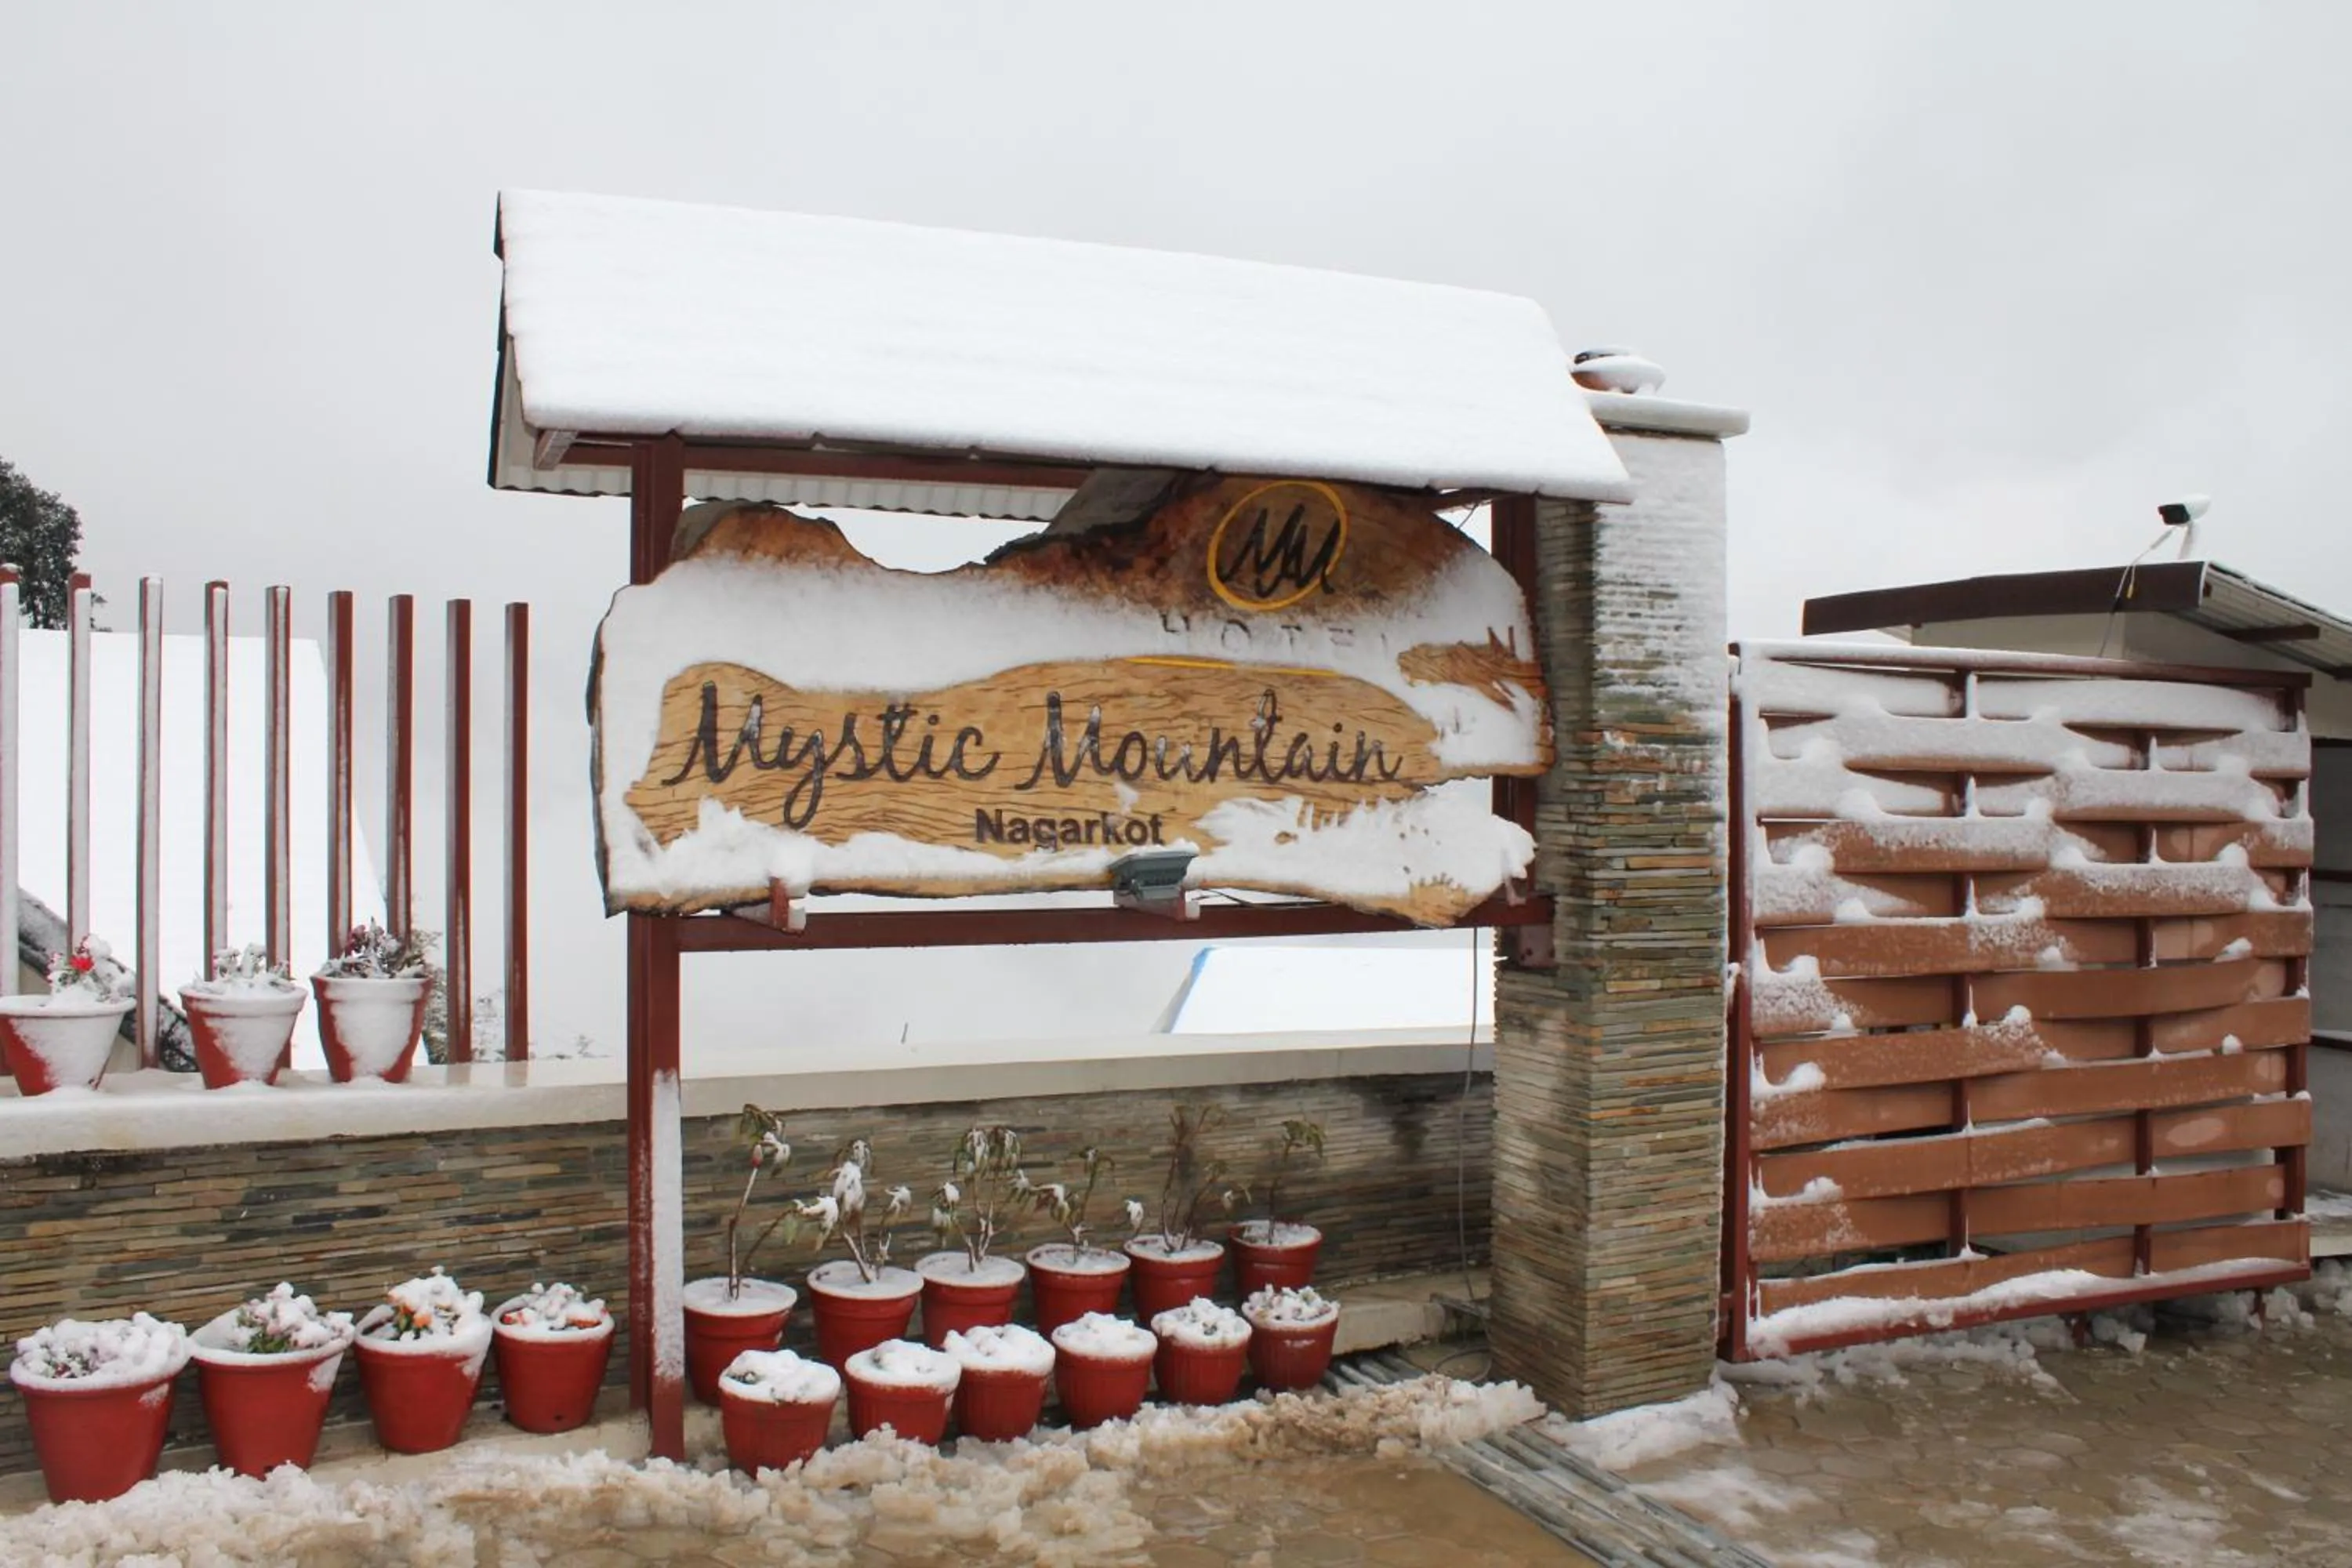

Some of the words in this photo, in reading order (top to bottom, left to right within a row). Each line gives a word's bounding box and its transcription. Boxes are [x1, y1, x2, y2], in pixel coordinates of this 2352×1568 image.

[662, 681, 1001, 829] Mystic
[1014, 689, 1403, 789] Mountain
[975, 808, 1166, 852] Nagarkot
